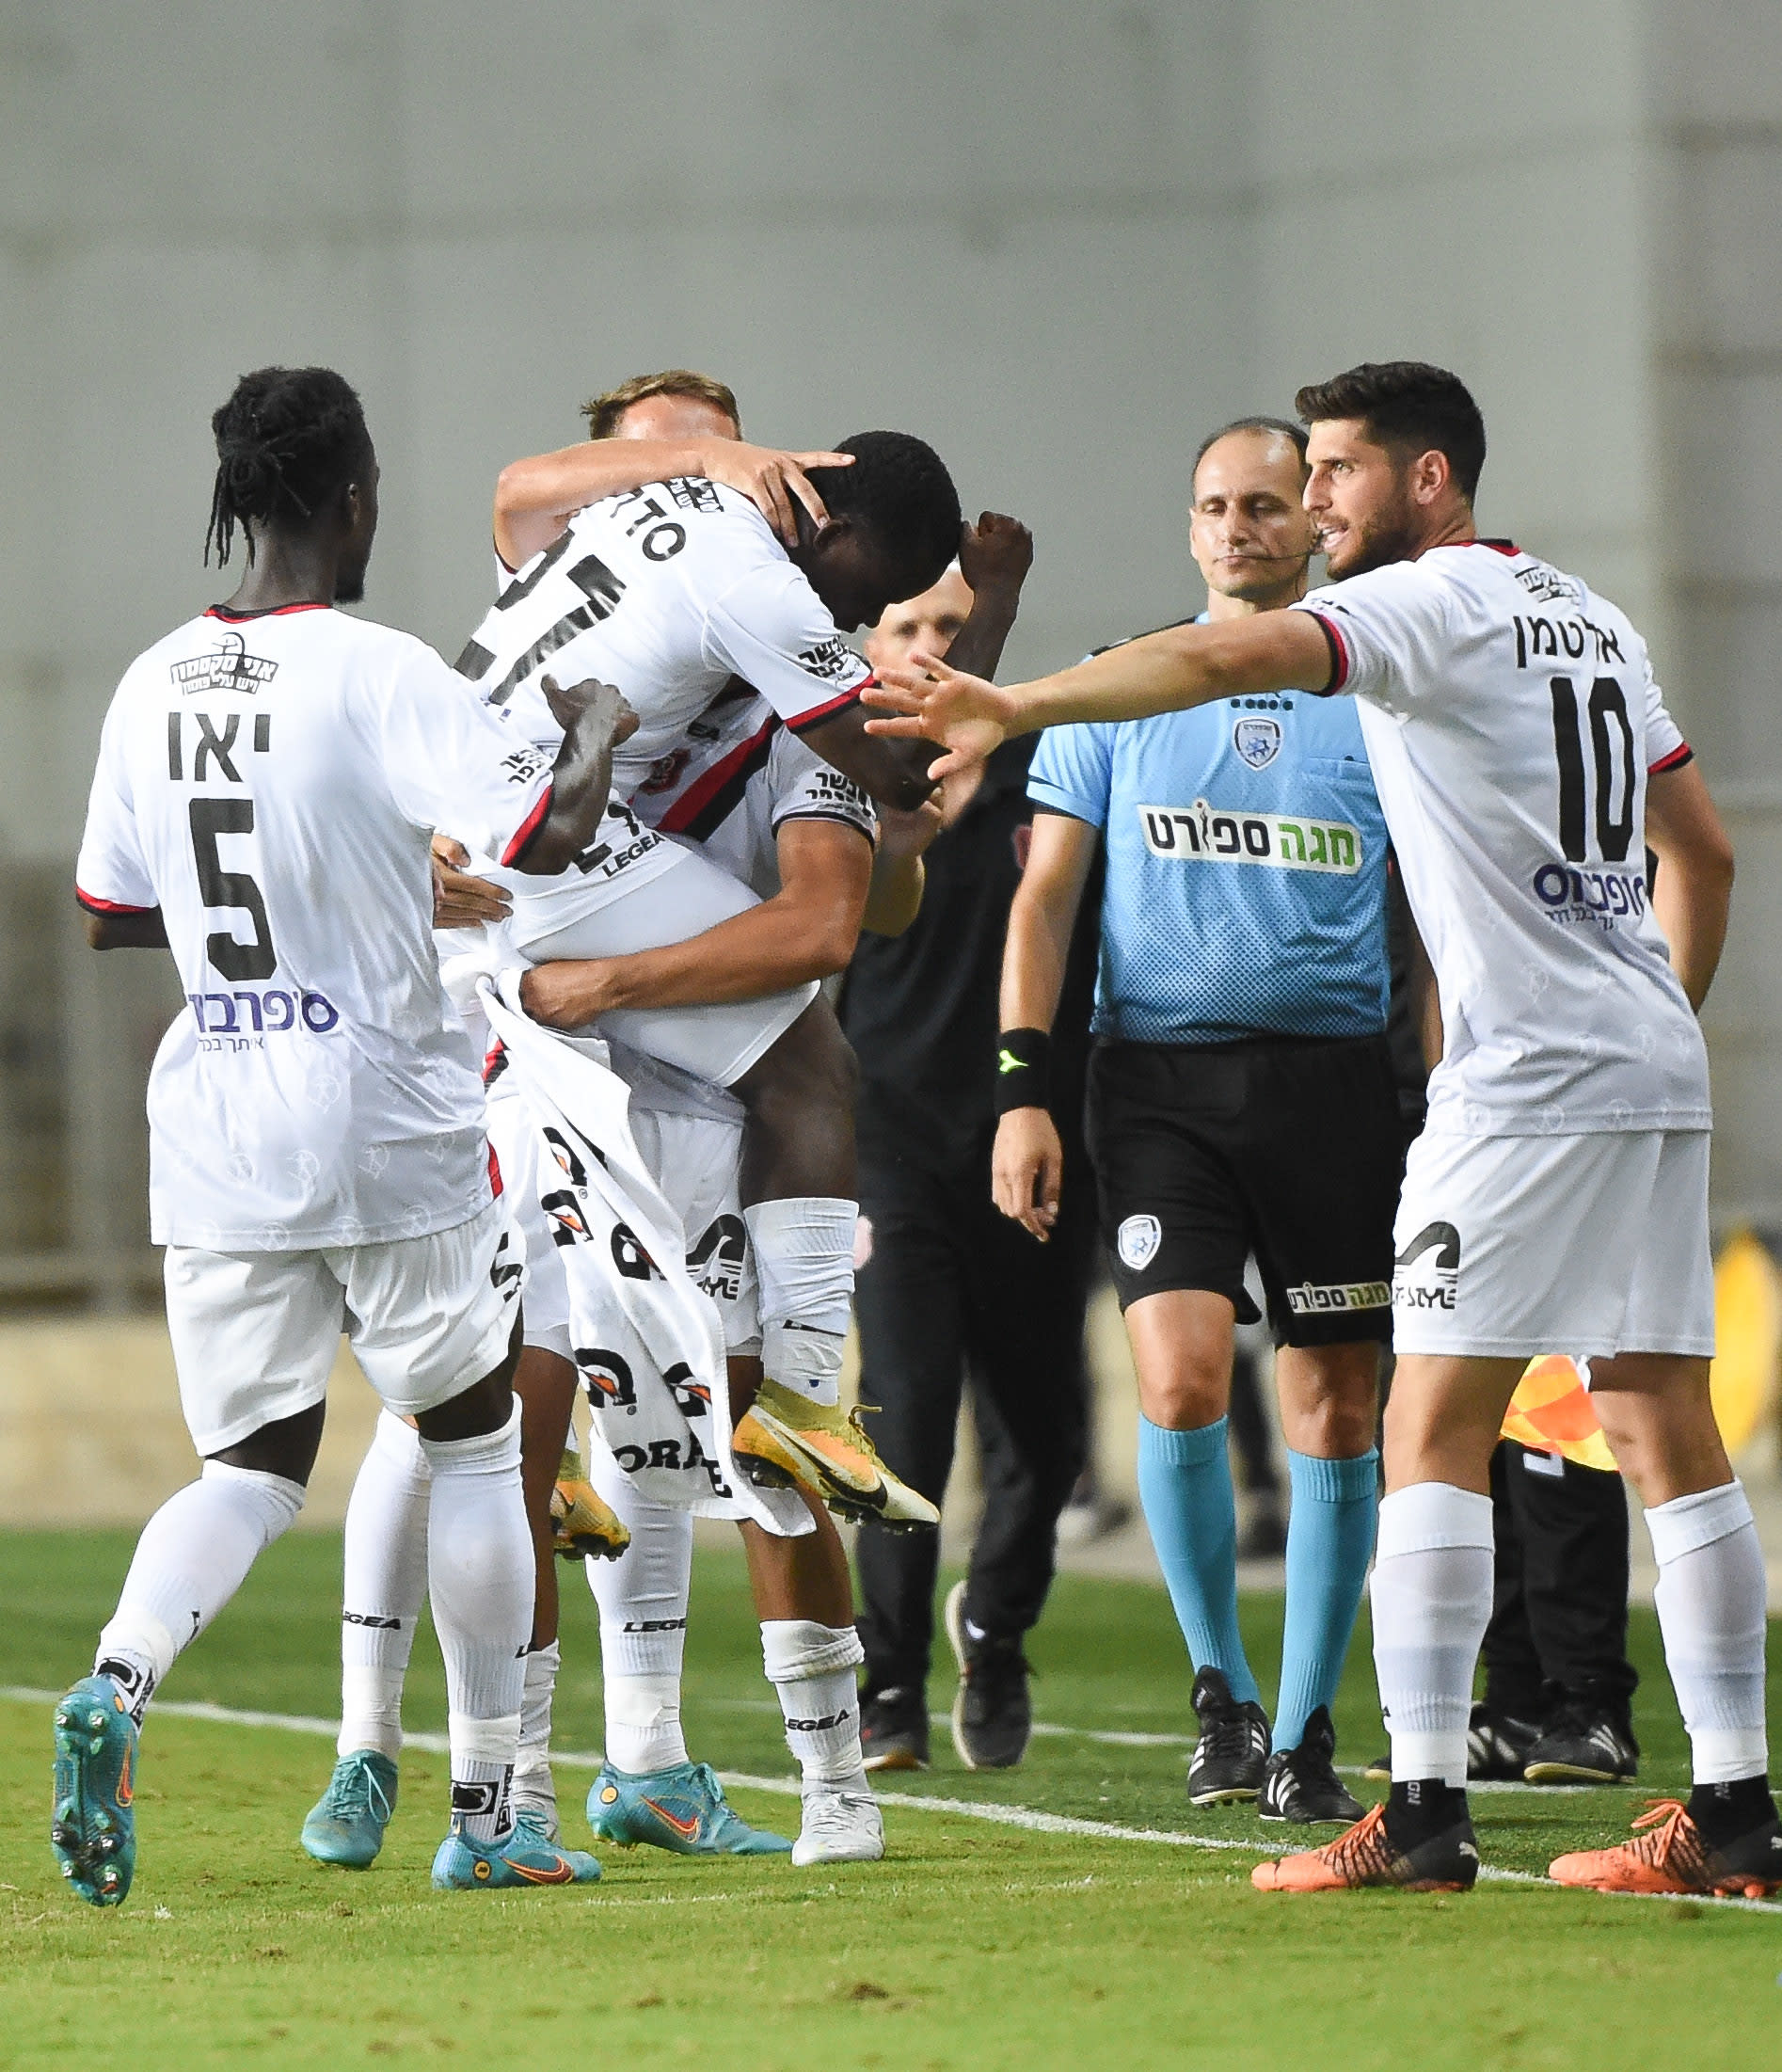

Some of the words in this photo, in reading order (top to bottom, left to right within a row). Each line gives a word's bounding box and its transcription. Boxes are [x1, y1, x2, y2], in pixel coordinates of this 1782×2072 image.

[1513, 614, 1627, 669] אלטמן
[167, 711, 271, 783] יאו
[1550, 677, 1635, 862] 10
[601, 832, 666, 878] LEGEA
[1146, 808, 1271, 858] ספורט
[1277, 822, 1357, 868] מגה
[189, 798, 277, 981] 5
[623, 1618, 687, 1633] LEGE
[787, 1709, 850, 1731] EGEA
